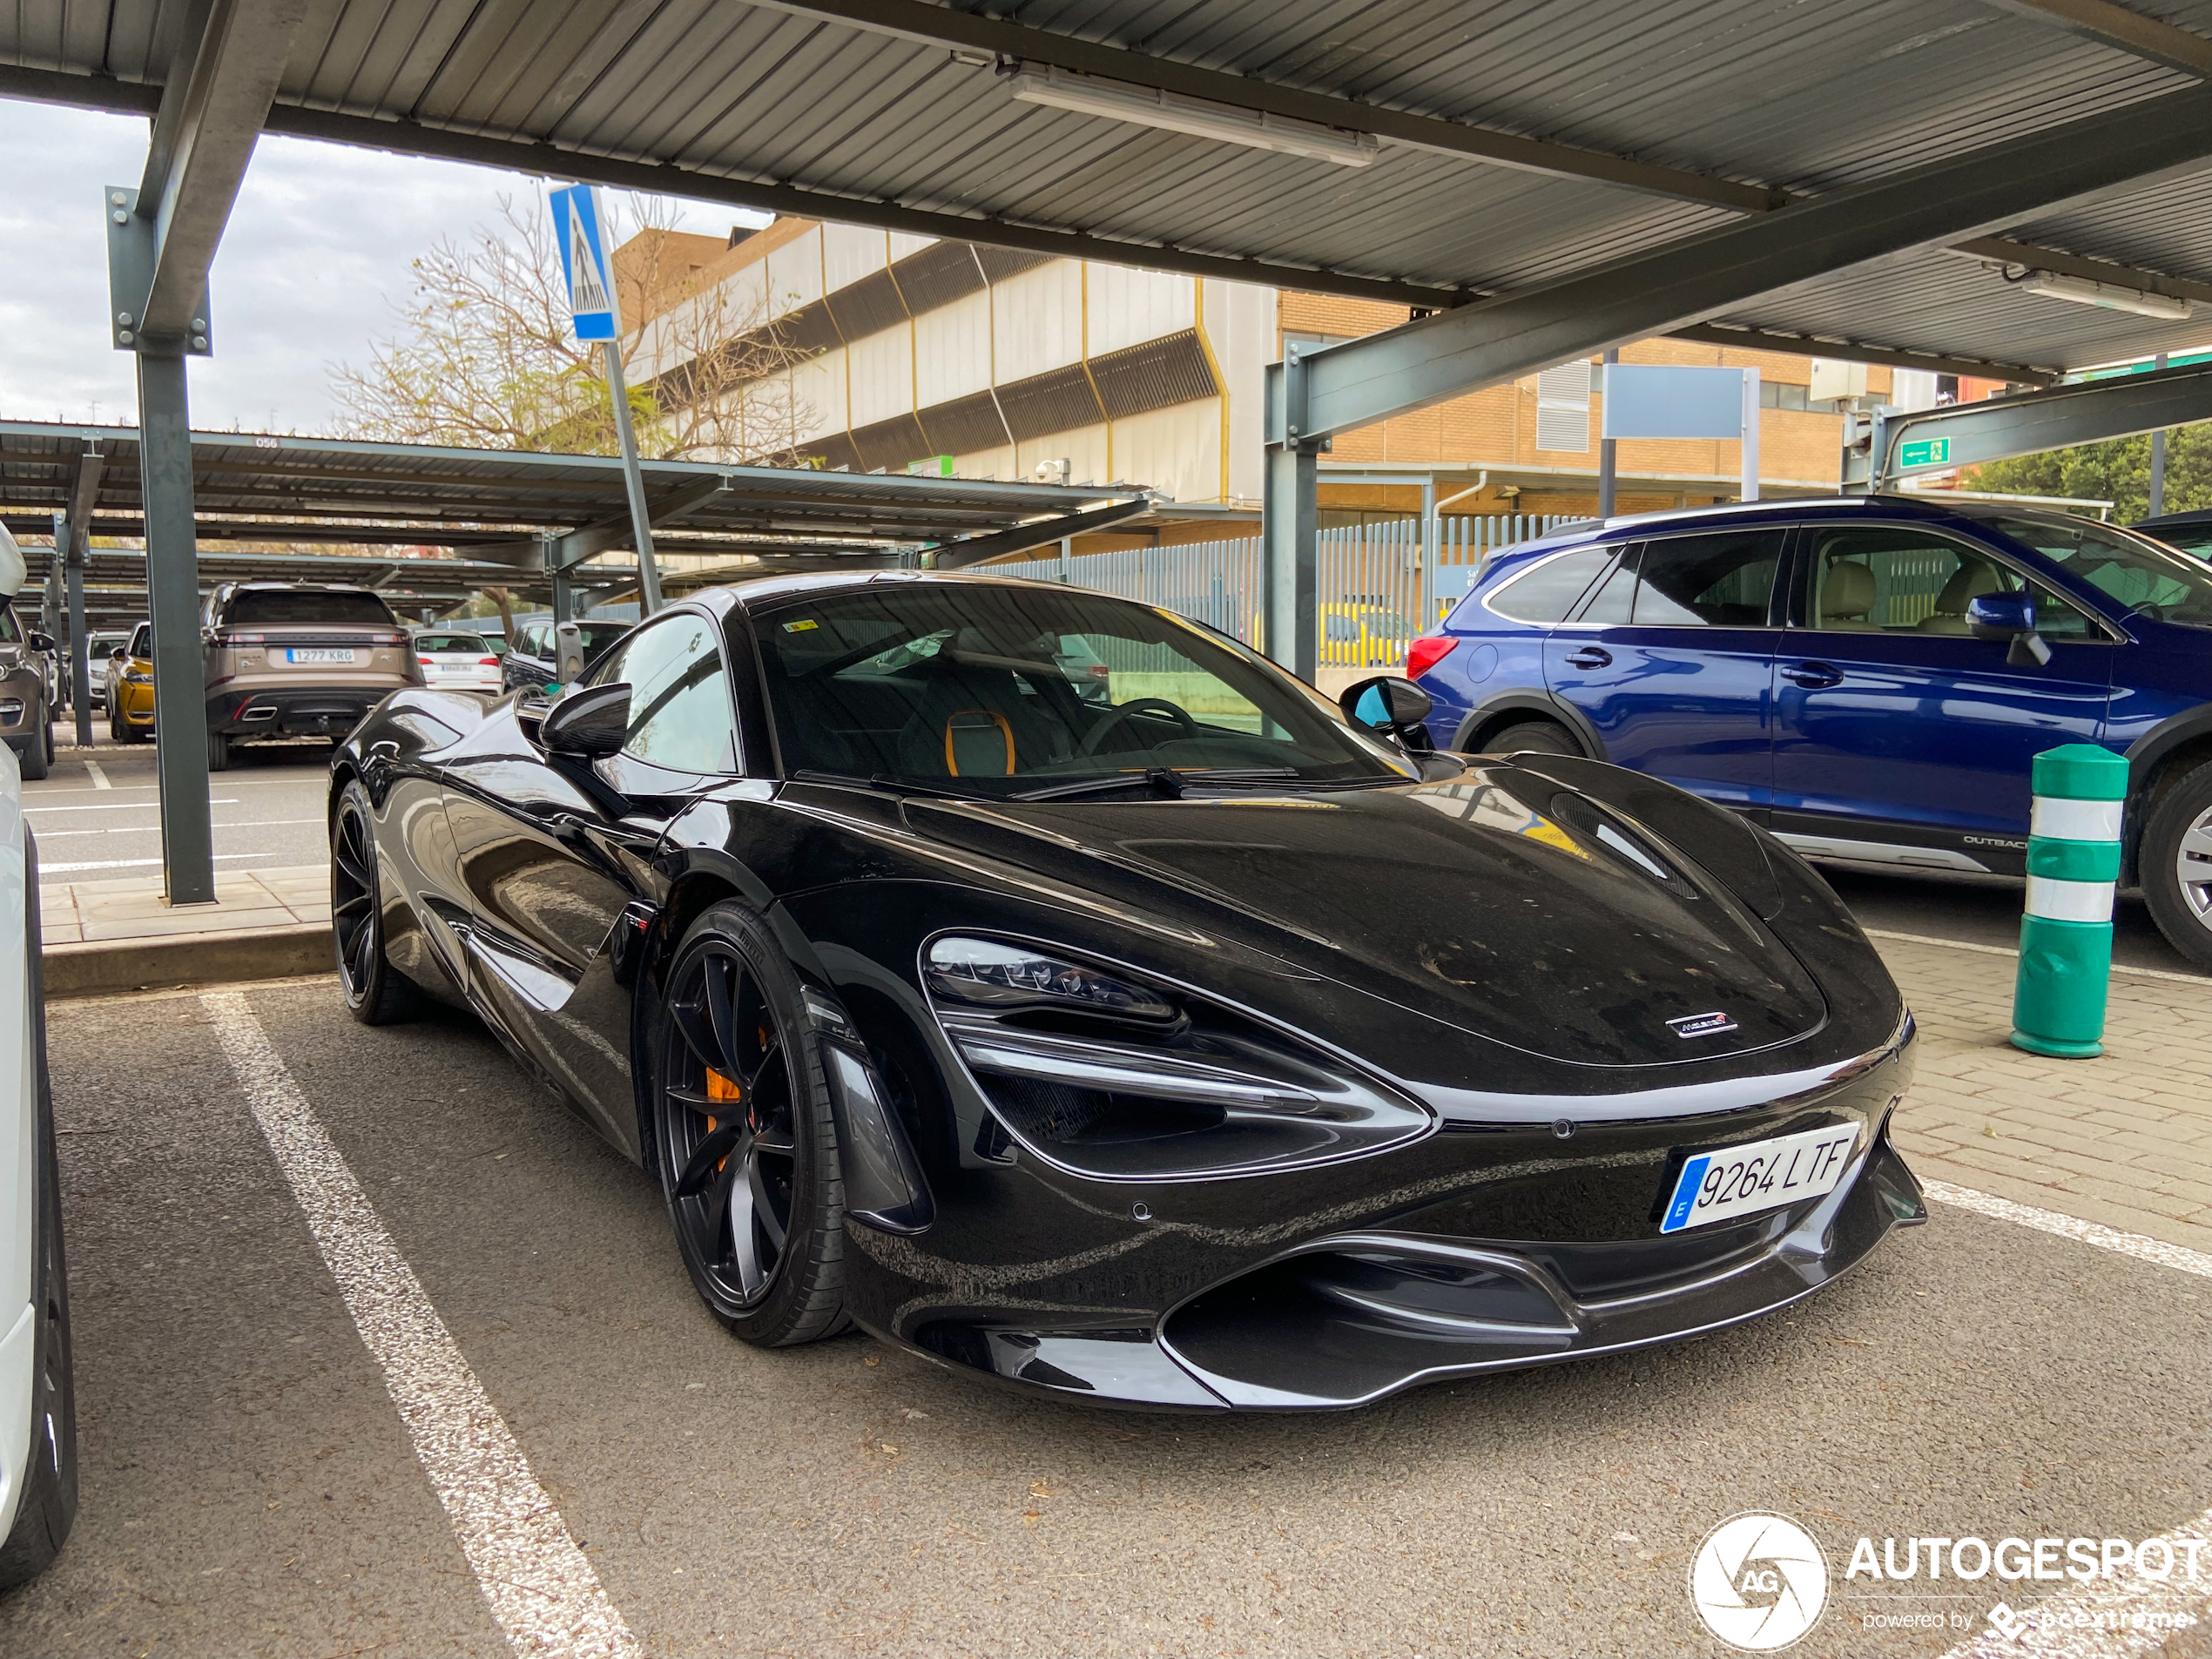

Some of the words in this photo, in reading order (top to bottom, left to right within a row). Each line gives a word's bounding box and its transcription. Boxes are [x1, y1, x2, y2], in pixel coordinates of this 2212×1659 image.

[297, 651, 326, 660] 1277
[329, 651, 352, 660] KRG
[738, 927, 765, 966] PIRELLI
[1697, 1153, 1782, 1209] 9264
[1782, 1138, 1850, 1190] LTF
[1675, 1201, 1688, 1217] E
